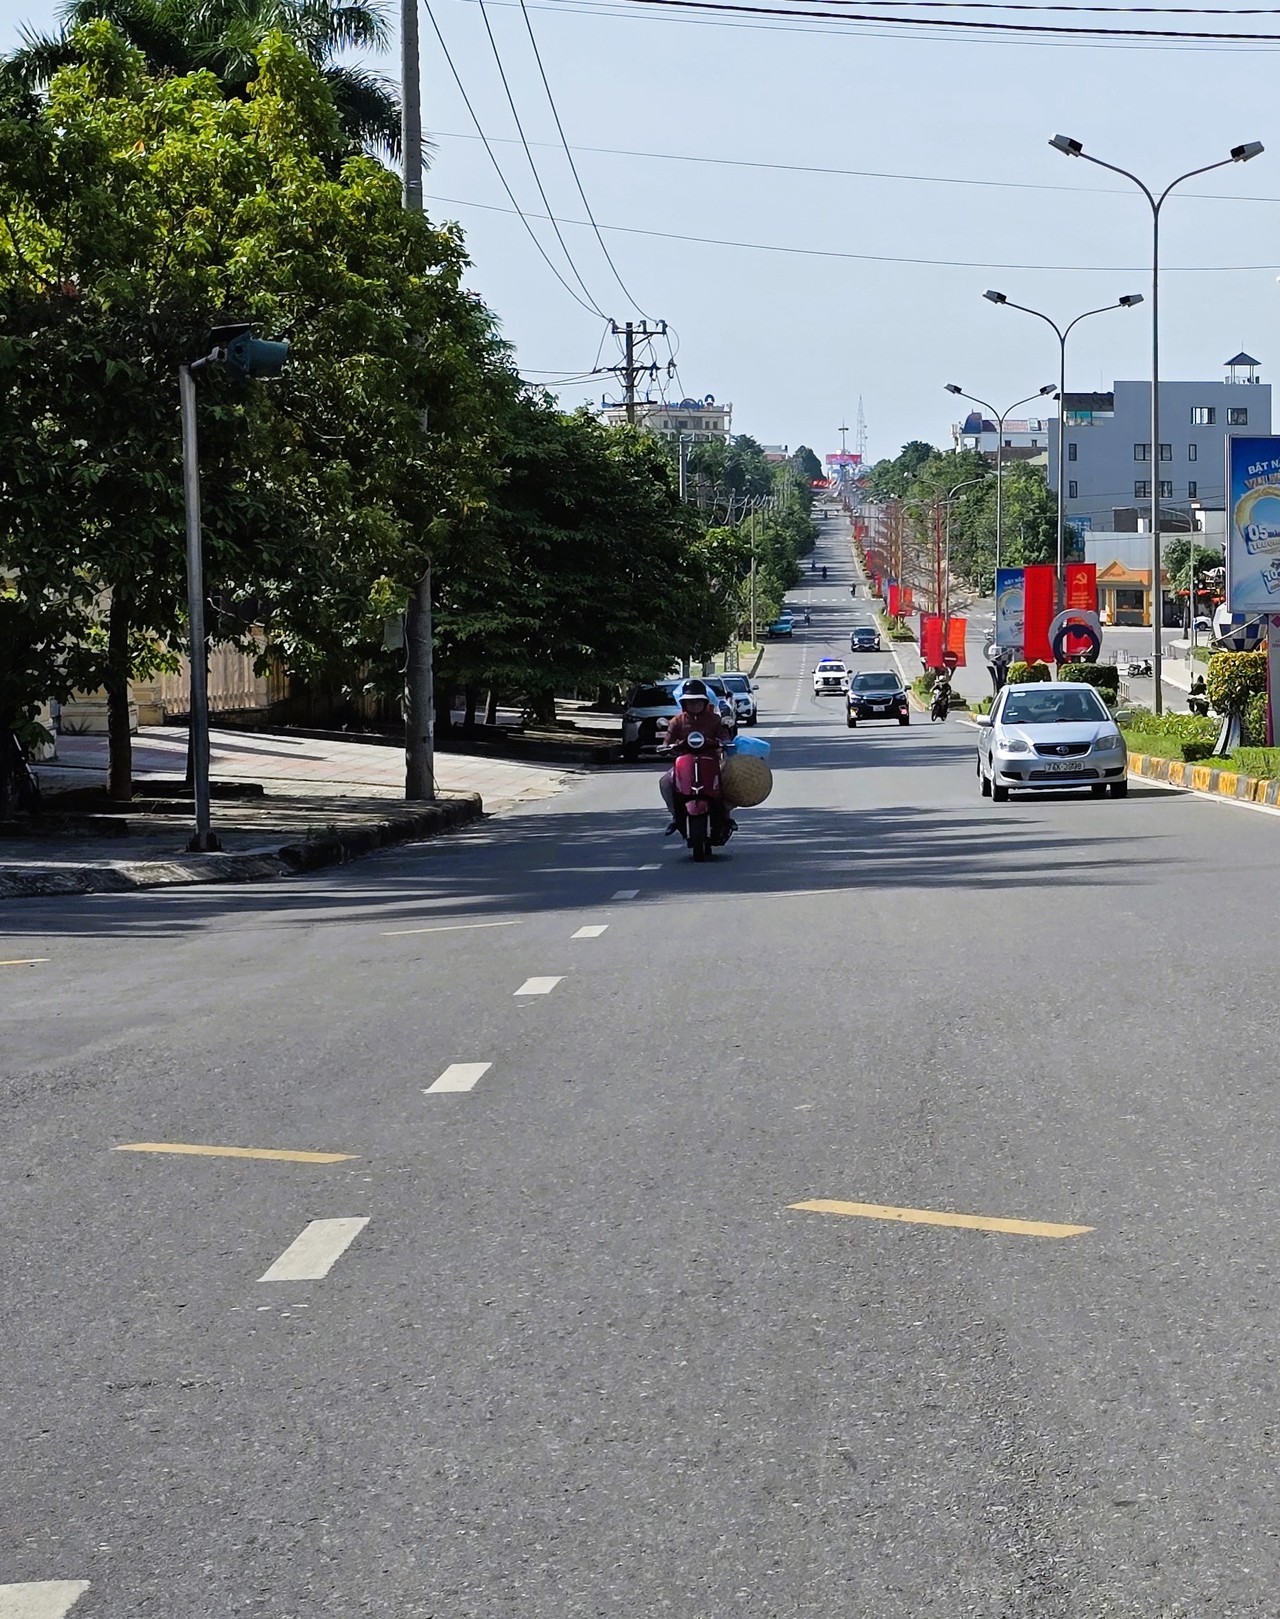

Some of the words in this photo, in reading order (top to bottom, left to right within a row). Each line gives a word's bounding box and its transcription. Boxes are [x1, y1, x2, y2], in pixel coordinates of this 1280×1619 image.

[1248, 462, 1269, 475] BẬT
[1248, 524, 1268, 540] 05
[1264, 569, 1278, 582] 10
